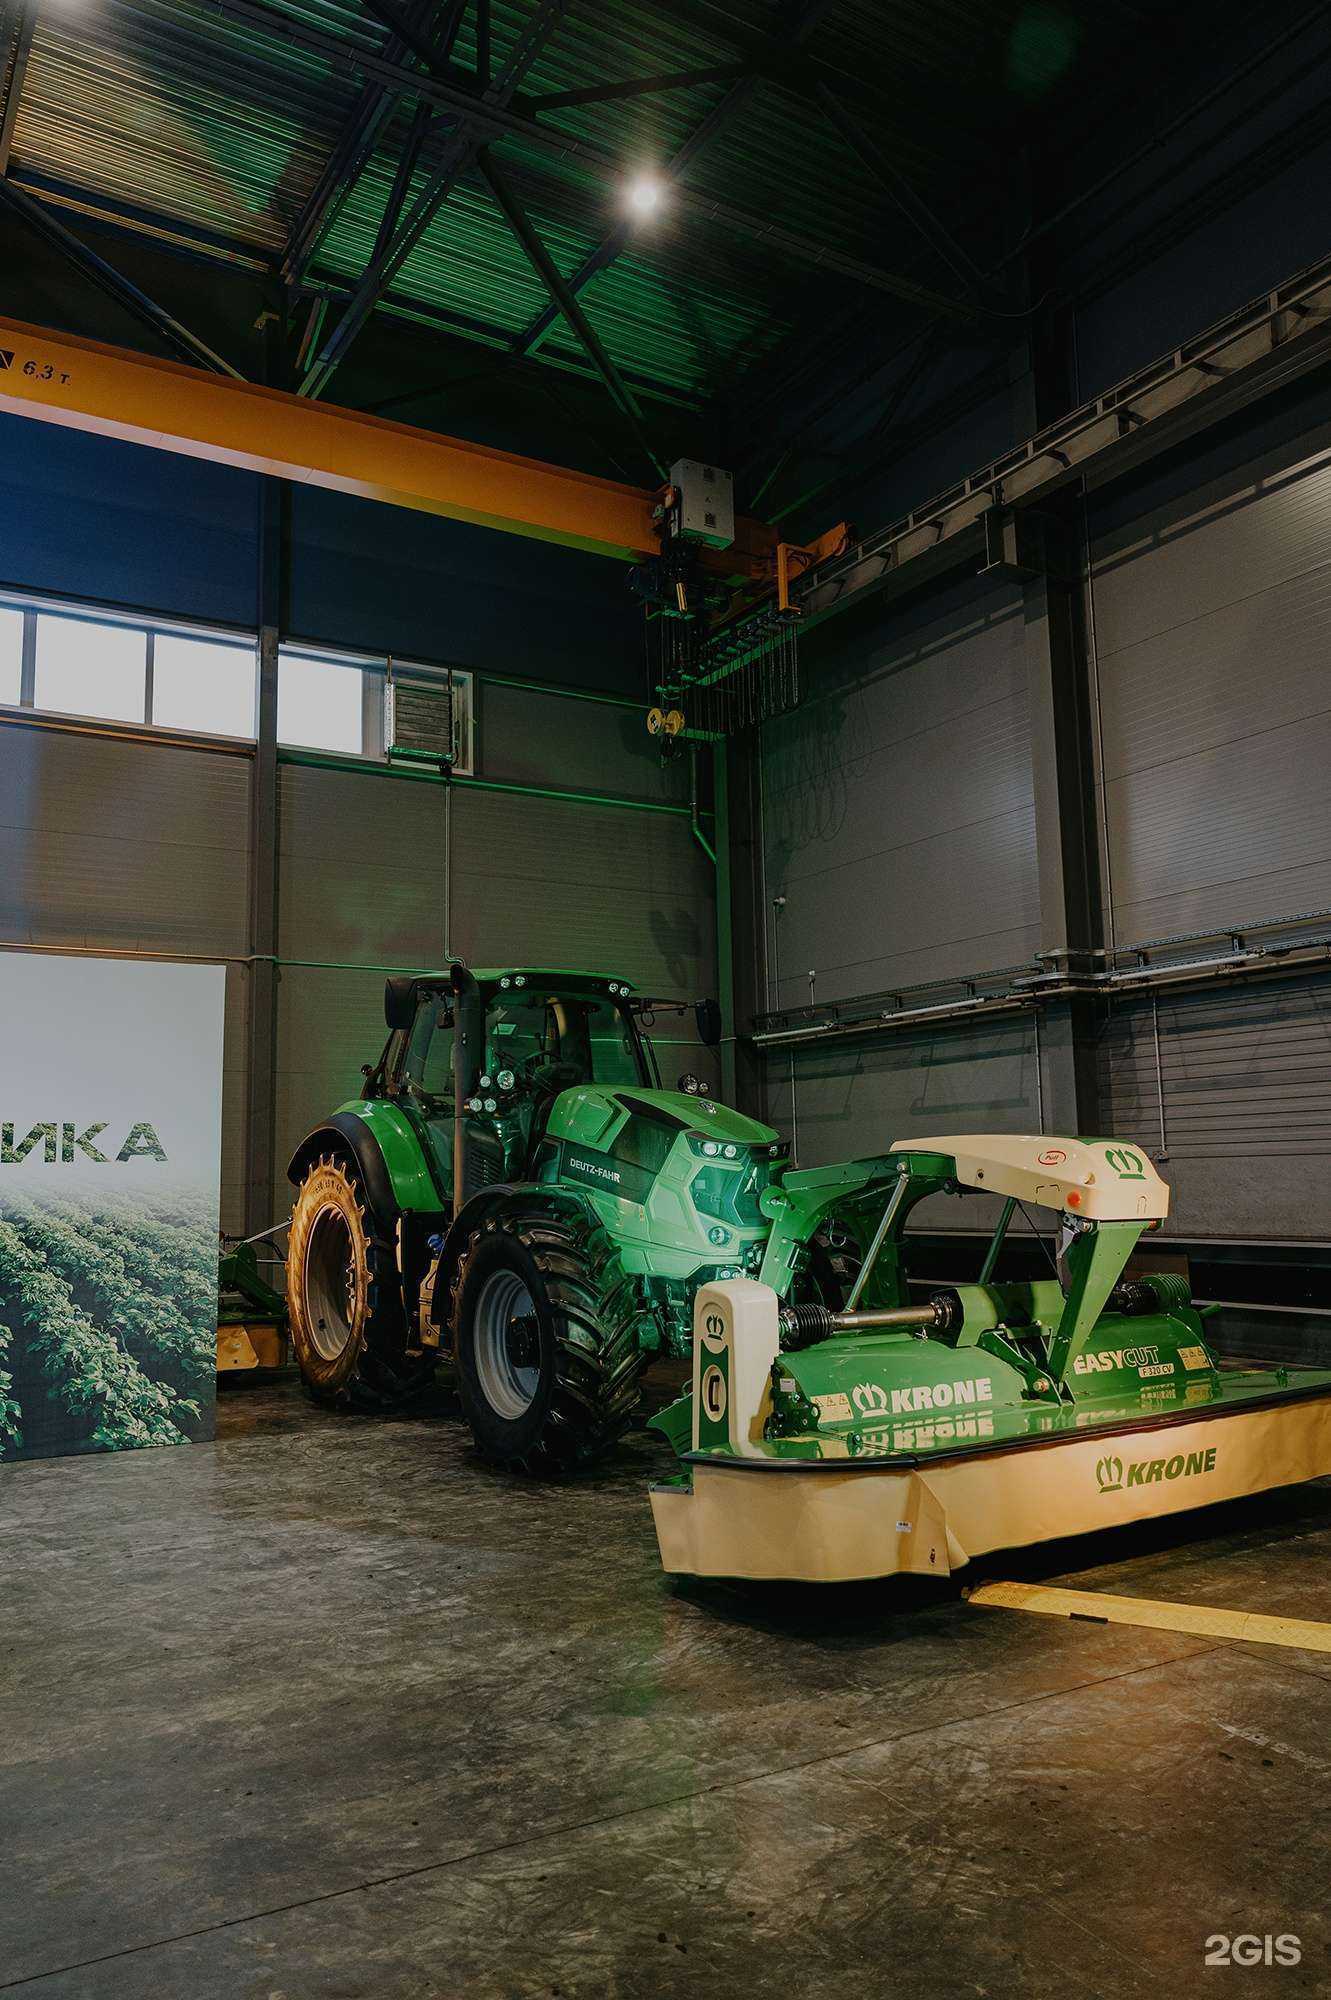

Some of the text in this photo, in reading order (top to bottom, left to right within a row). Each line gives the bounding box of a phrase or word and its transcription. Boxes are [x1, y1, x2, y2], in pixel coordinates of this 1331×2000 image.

[0, 1122, 168, 1163] ИКА
[570, 1158, 620, 1183] DEUTZ-FAHR
[1073, 1346, 1159, 1375] EASYCUT
[892, 1378, 993, 1414] KRONE
[1127, 1448, 1217, 1488] KRONE
